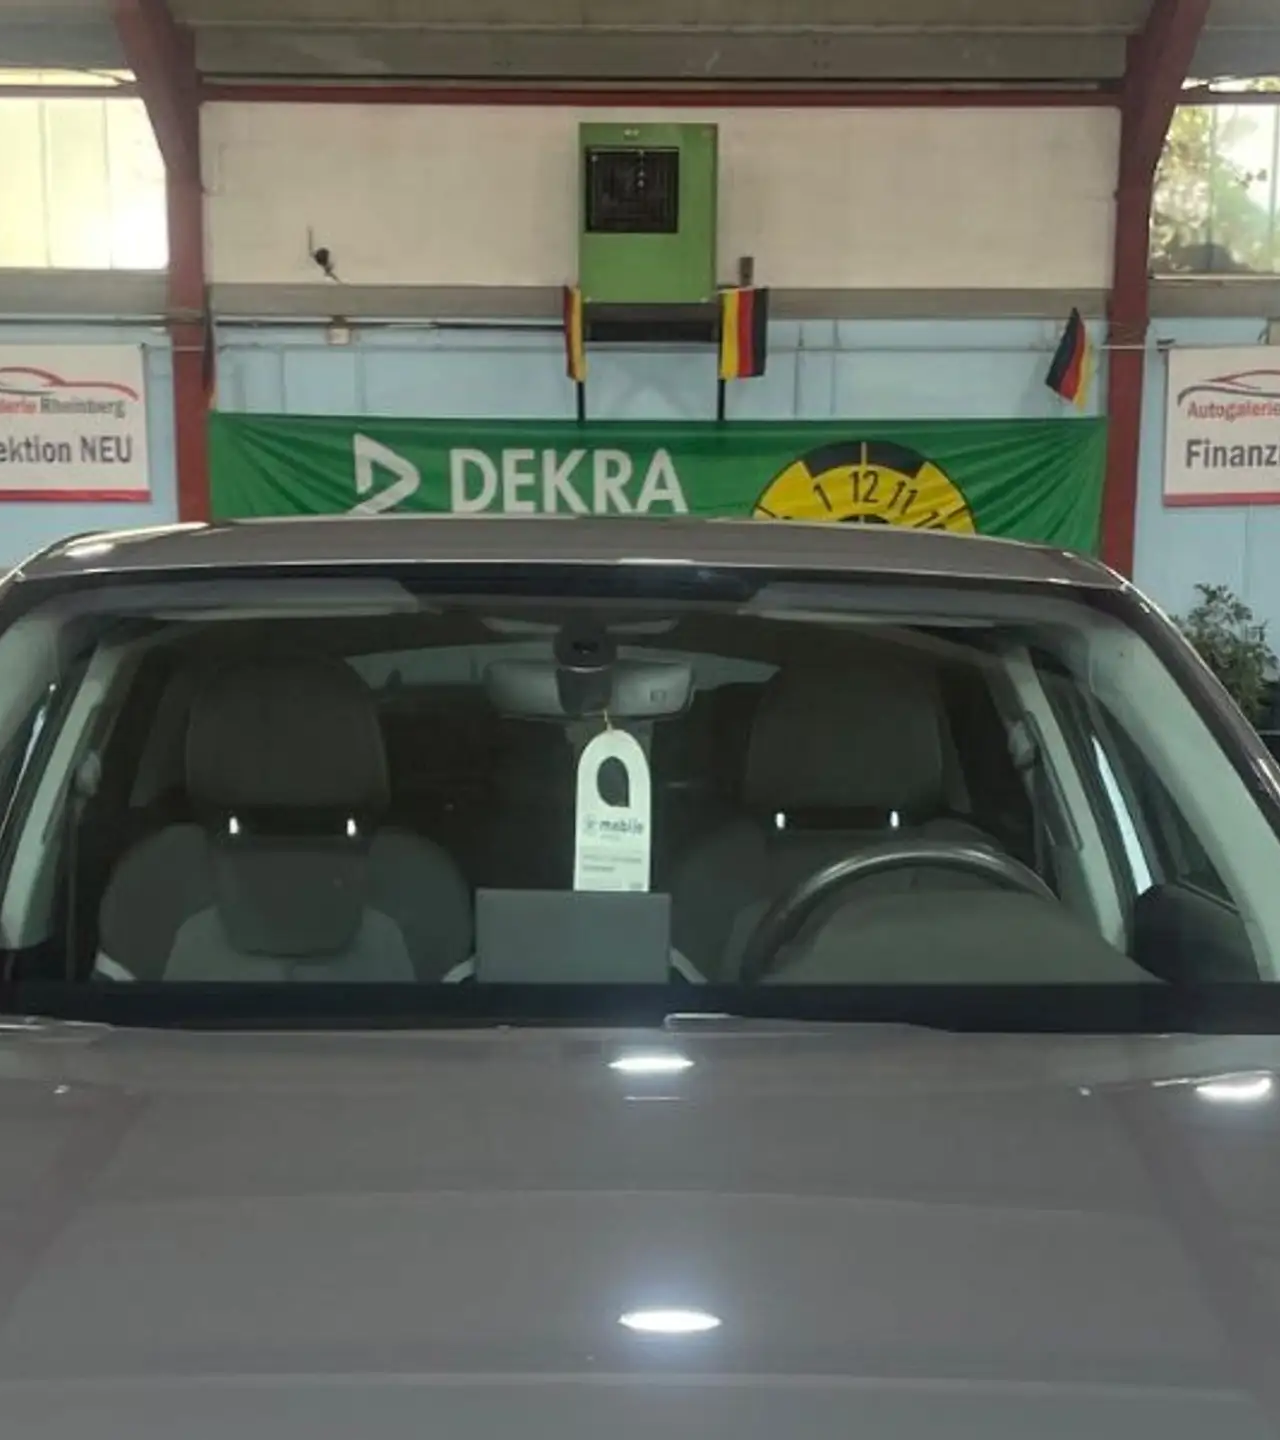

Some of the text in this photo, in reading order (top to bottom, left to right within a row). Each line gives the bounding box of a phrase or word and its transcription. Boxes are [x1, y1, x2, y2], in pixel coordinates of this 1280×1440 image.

[79, 434, 133, 464] NEU
[449, 447, 689, 515] DEKRA
[813, 484, 833, 513] 1
[848, 470, 879, 505] 12
[887, 480, 919, 516] 11
